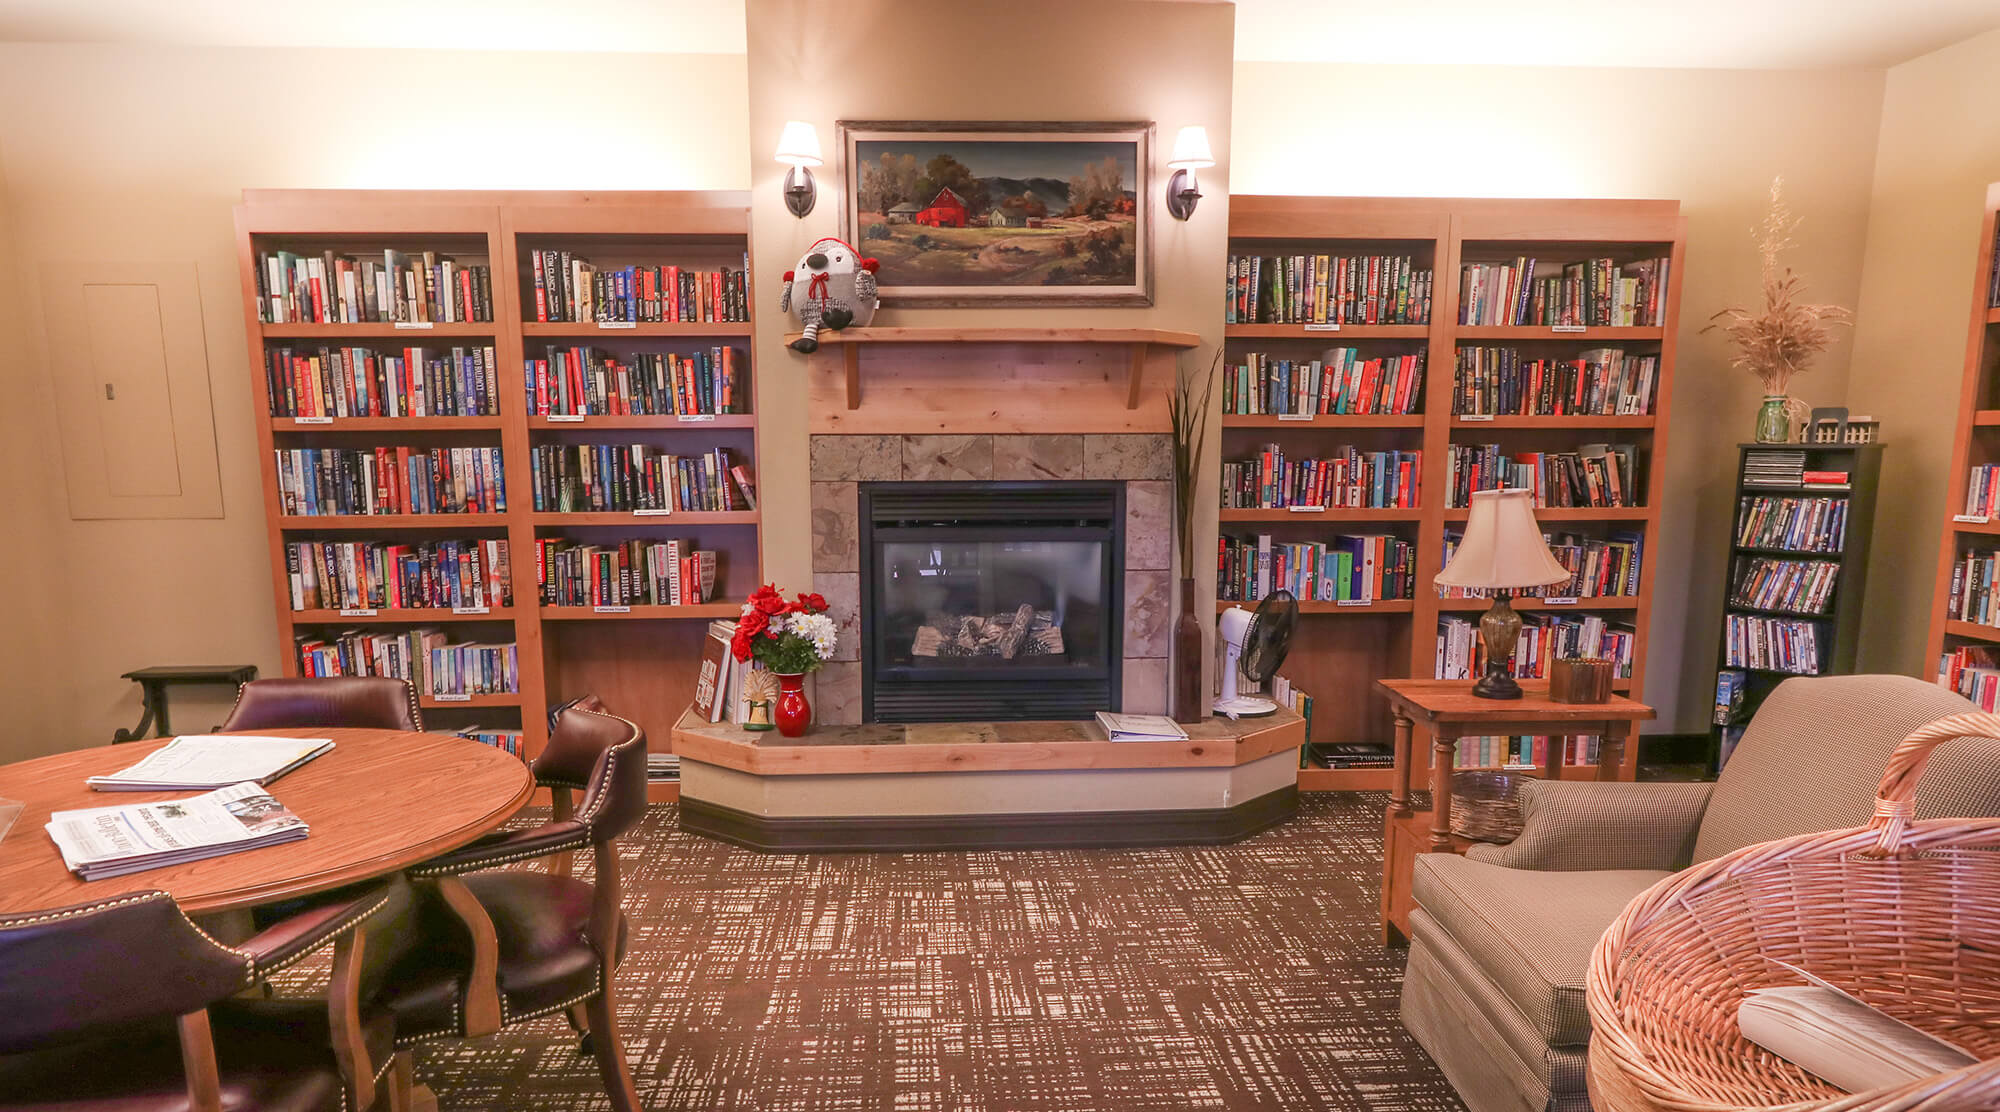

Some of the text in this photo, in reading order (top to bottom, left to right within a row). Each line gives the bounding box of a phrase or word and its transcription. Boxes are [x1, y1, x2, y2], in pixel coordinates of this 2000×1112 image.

[473, 350, 484, 390] DAVID BALDACCI
[1624, 396, 1634, 413] H
[493, 463, 501, 480] BOX
[1224, 489, 1228, 506] E
[1351, 487, 1357, 505] F
[325, 546, 335, 576] C.J. BOX
[470, 551, 481, 585] DAN BROWN
[670, 543, 680, 601] MICHAEL CRICHTON
[620, 570, 629, 599] DEADLOCK
[633, 570, 641, 597] LABYRINTH
[1325, 582, 1331, 598] G
